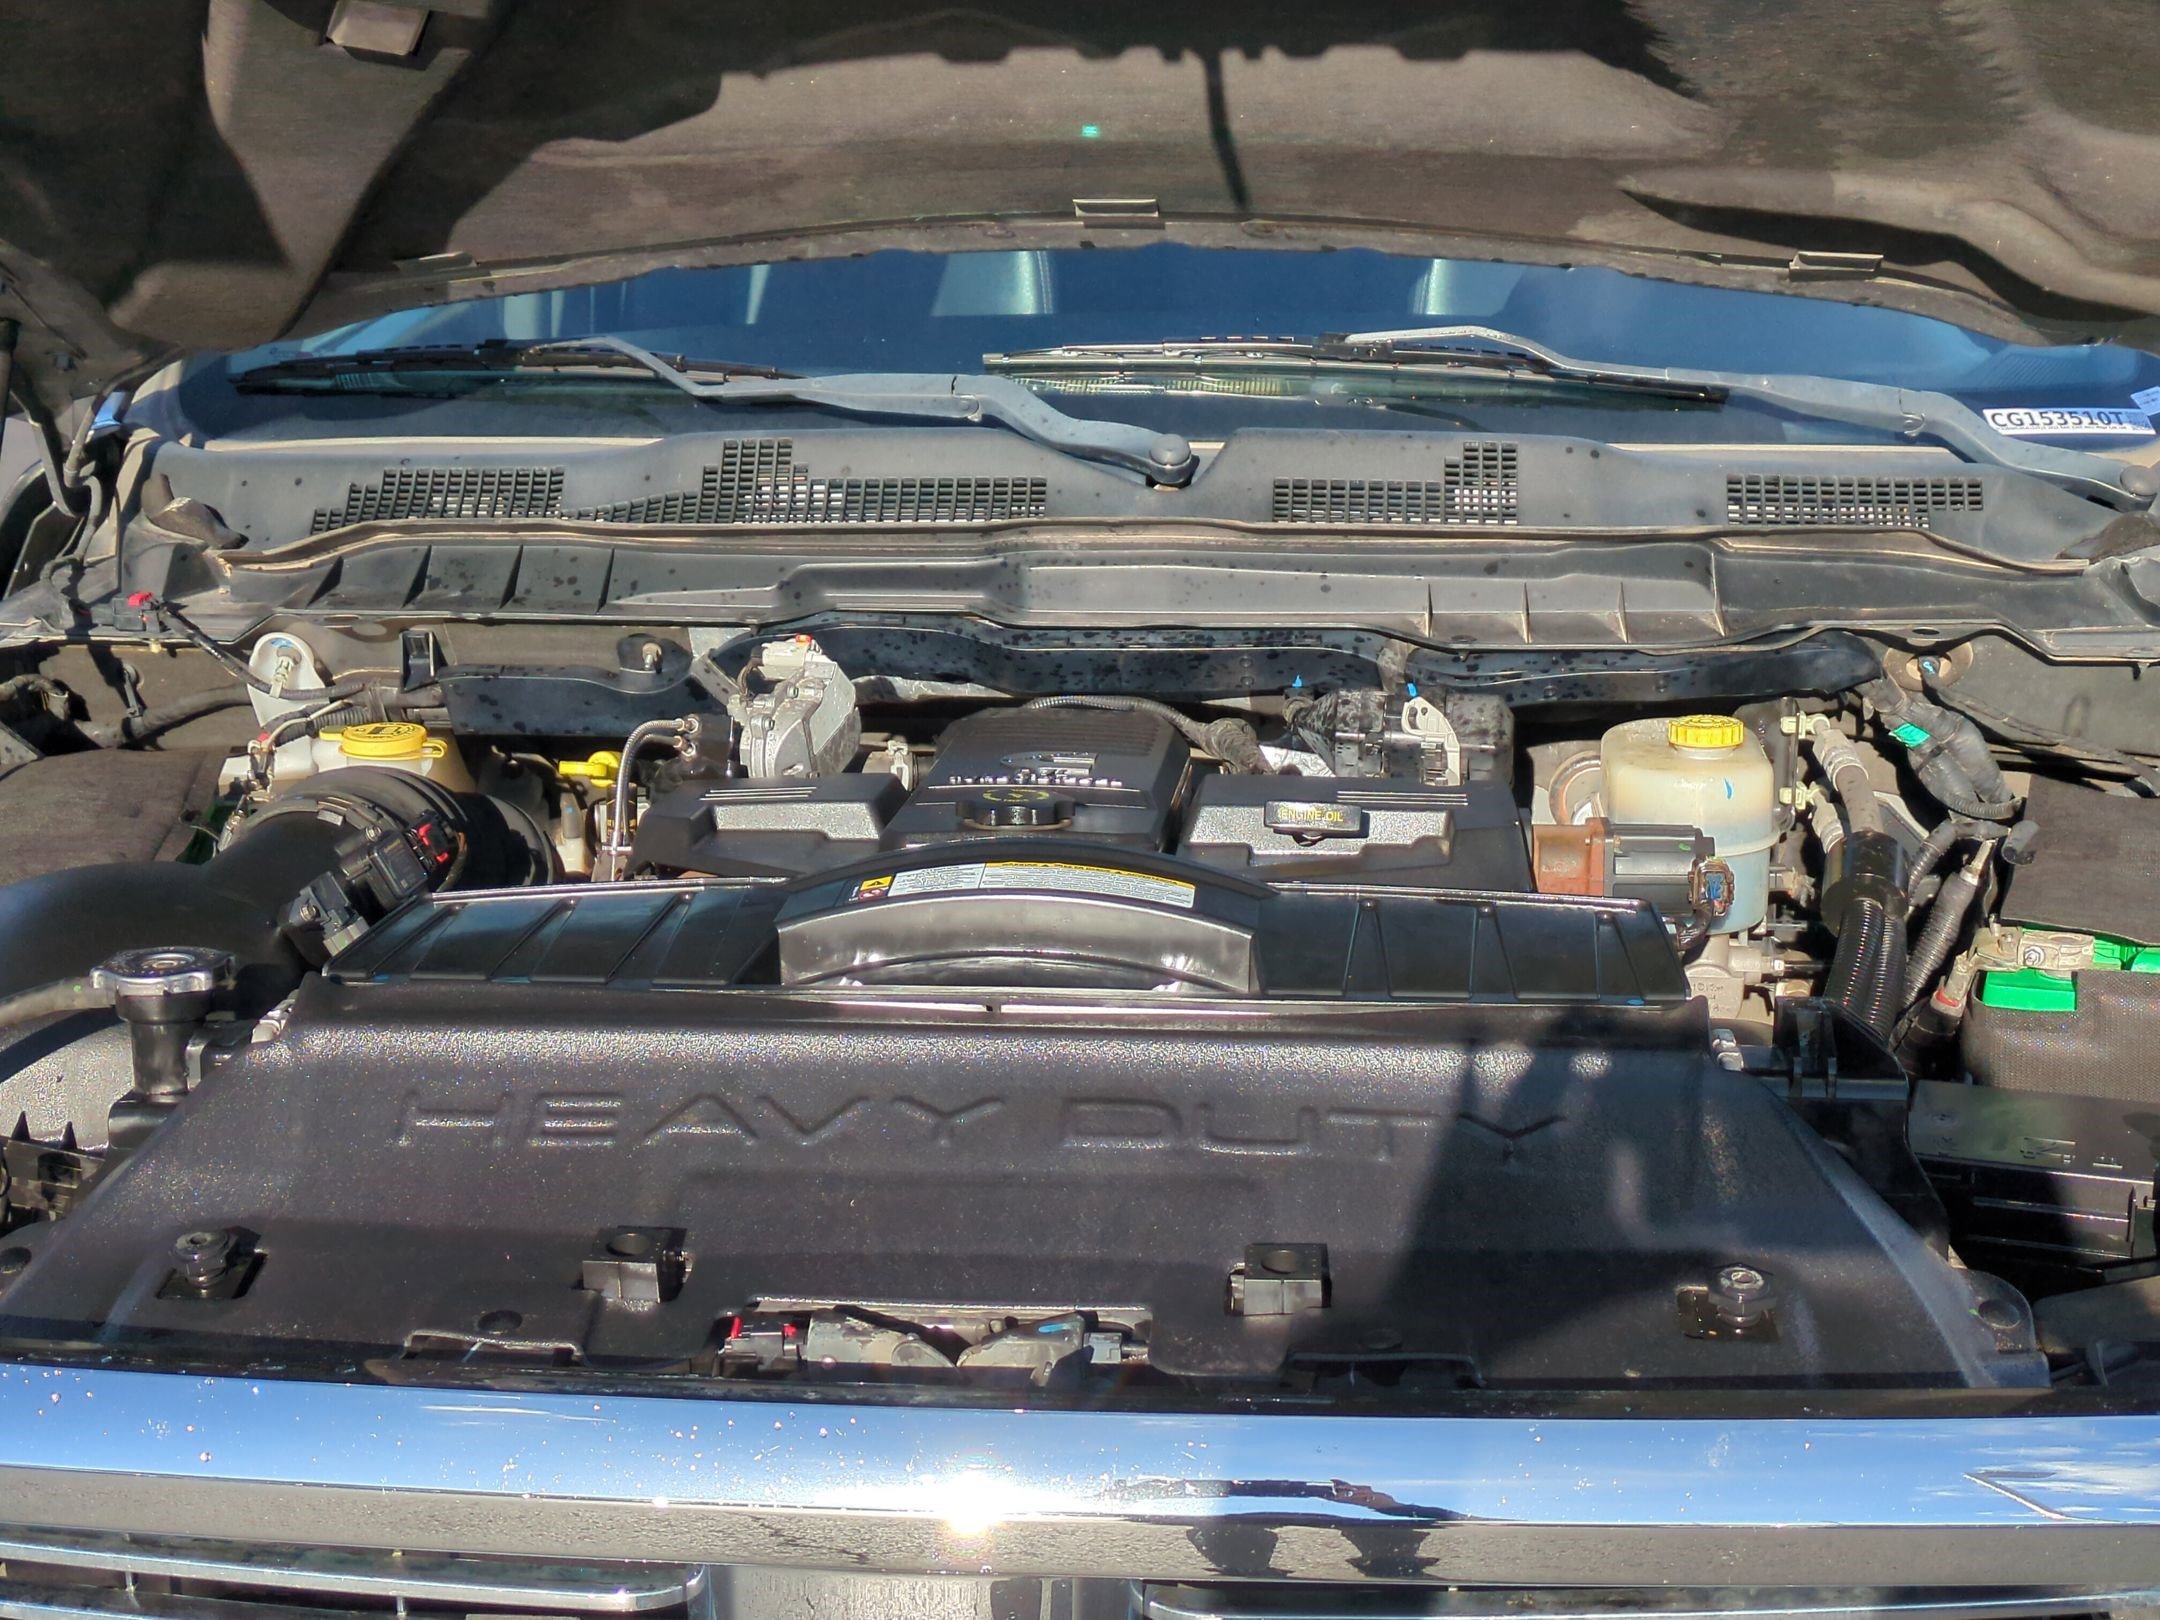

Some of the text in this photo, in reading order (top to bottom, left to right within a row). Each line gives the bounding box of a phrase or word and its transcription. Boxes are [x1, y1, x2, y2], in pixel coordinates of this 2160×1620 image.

[1990, 411, 2124, 427] CG153510T
[1278, 807, 1345, 823] ENGINE OIL
[396, 1093, 1568, 1163] HEAVY DUTY
